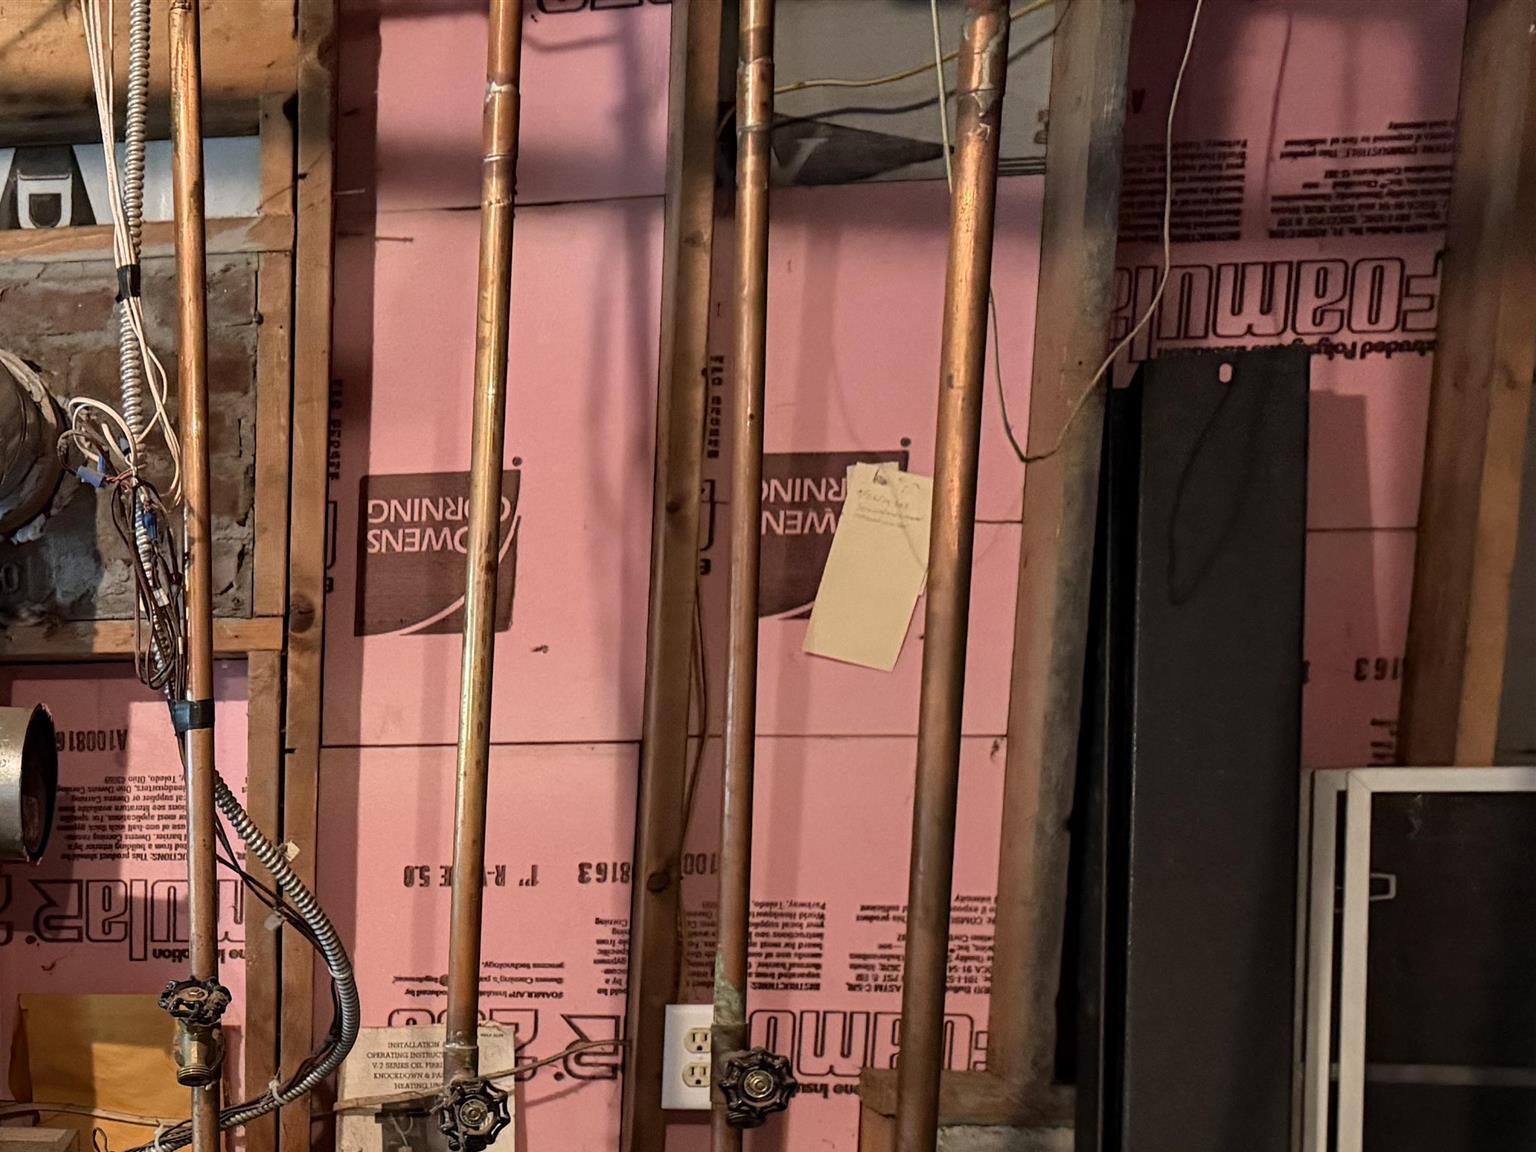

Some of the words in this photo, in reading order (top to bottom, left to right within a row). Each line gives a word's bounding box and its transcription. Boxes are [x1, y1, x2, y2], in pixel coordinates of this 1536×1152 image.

[1360, 341, 1438, 359] xtruded
[761, 508, 837, 534] WEN
[147, 775, 177, 783] Toledo,
[135, 784, 186, 793] eadquarters,
[141, 793, 172, 803] supplier
[115, 841, 146, 851] building
[131, 853, 148, 861] This
[403, 865, 431, 888] 5.0
[595, 918, 627, 927] Corning
